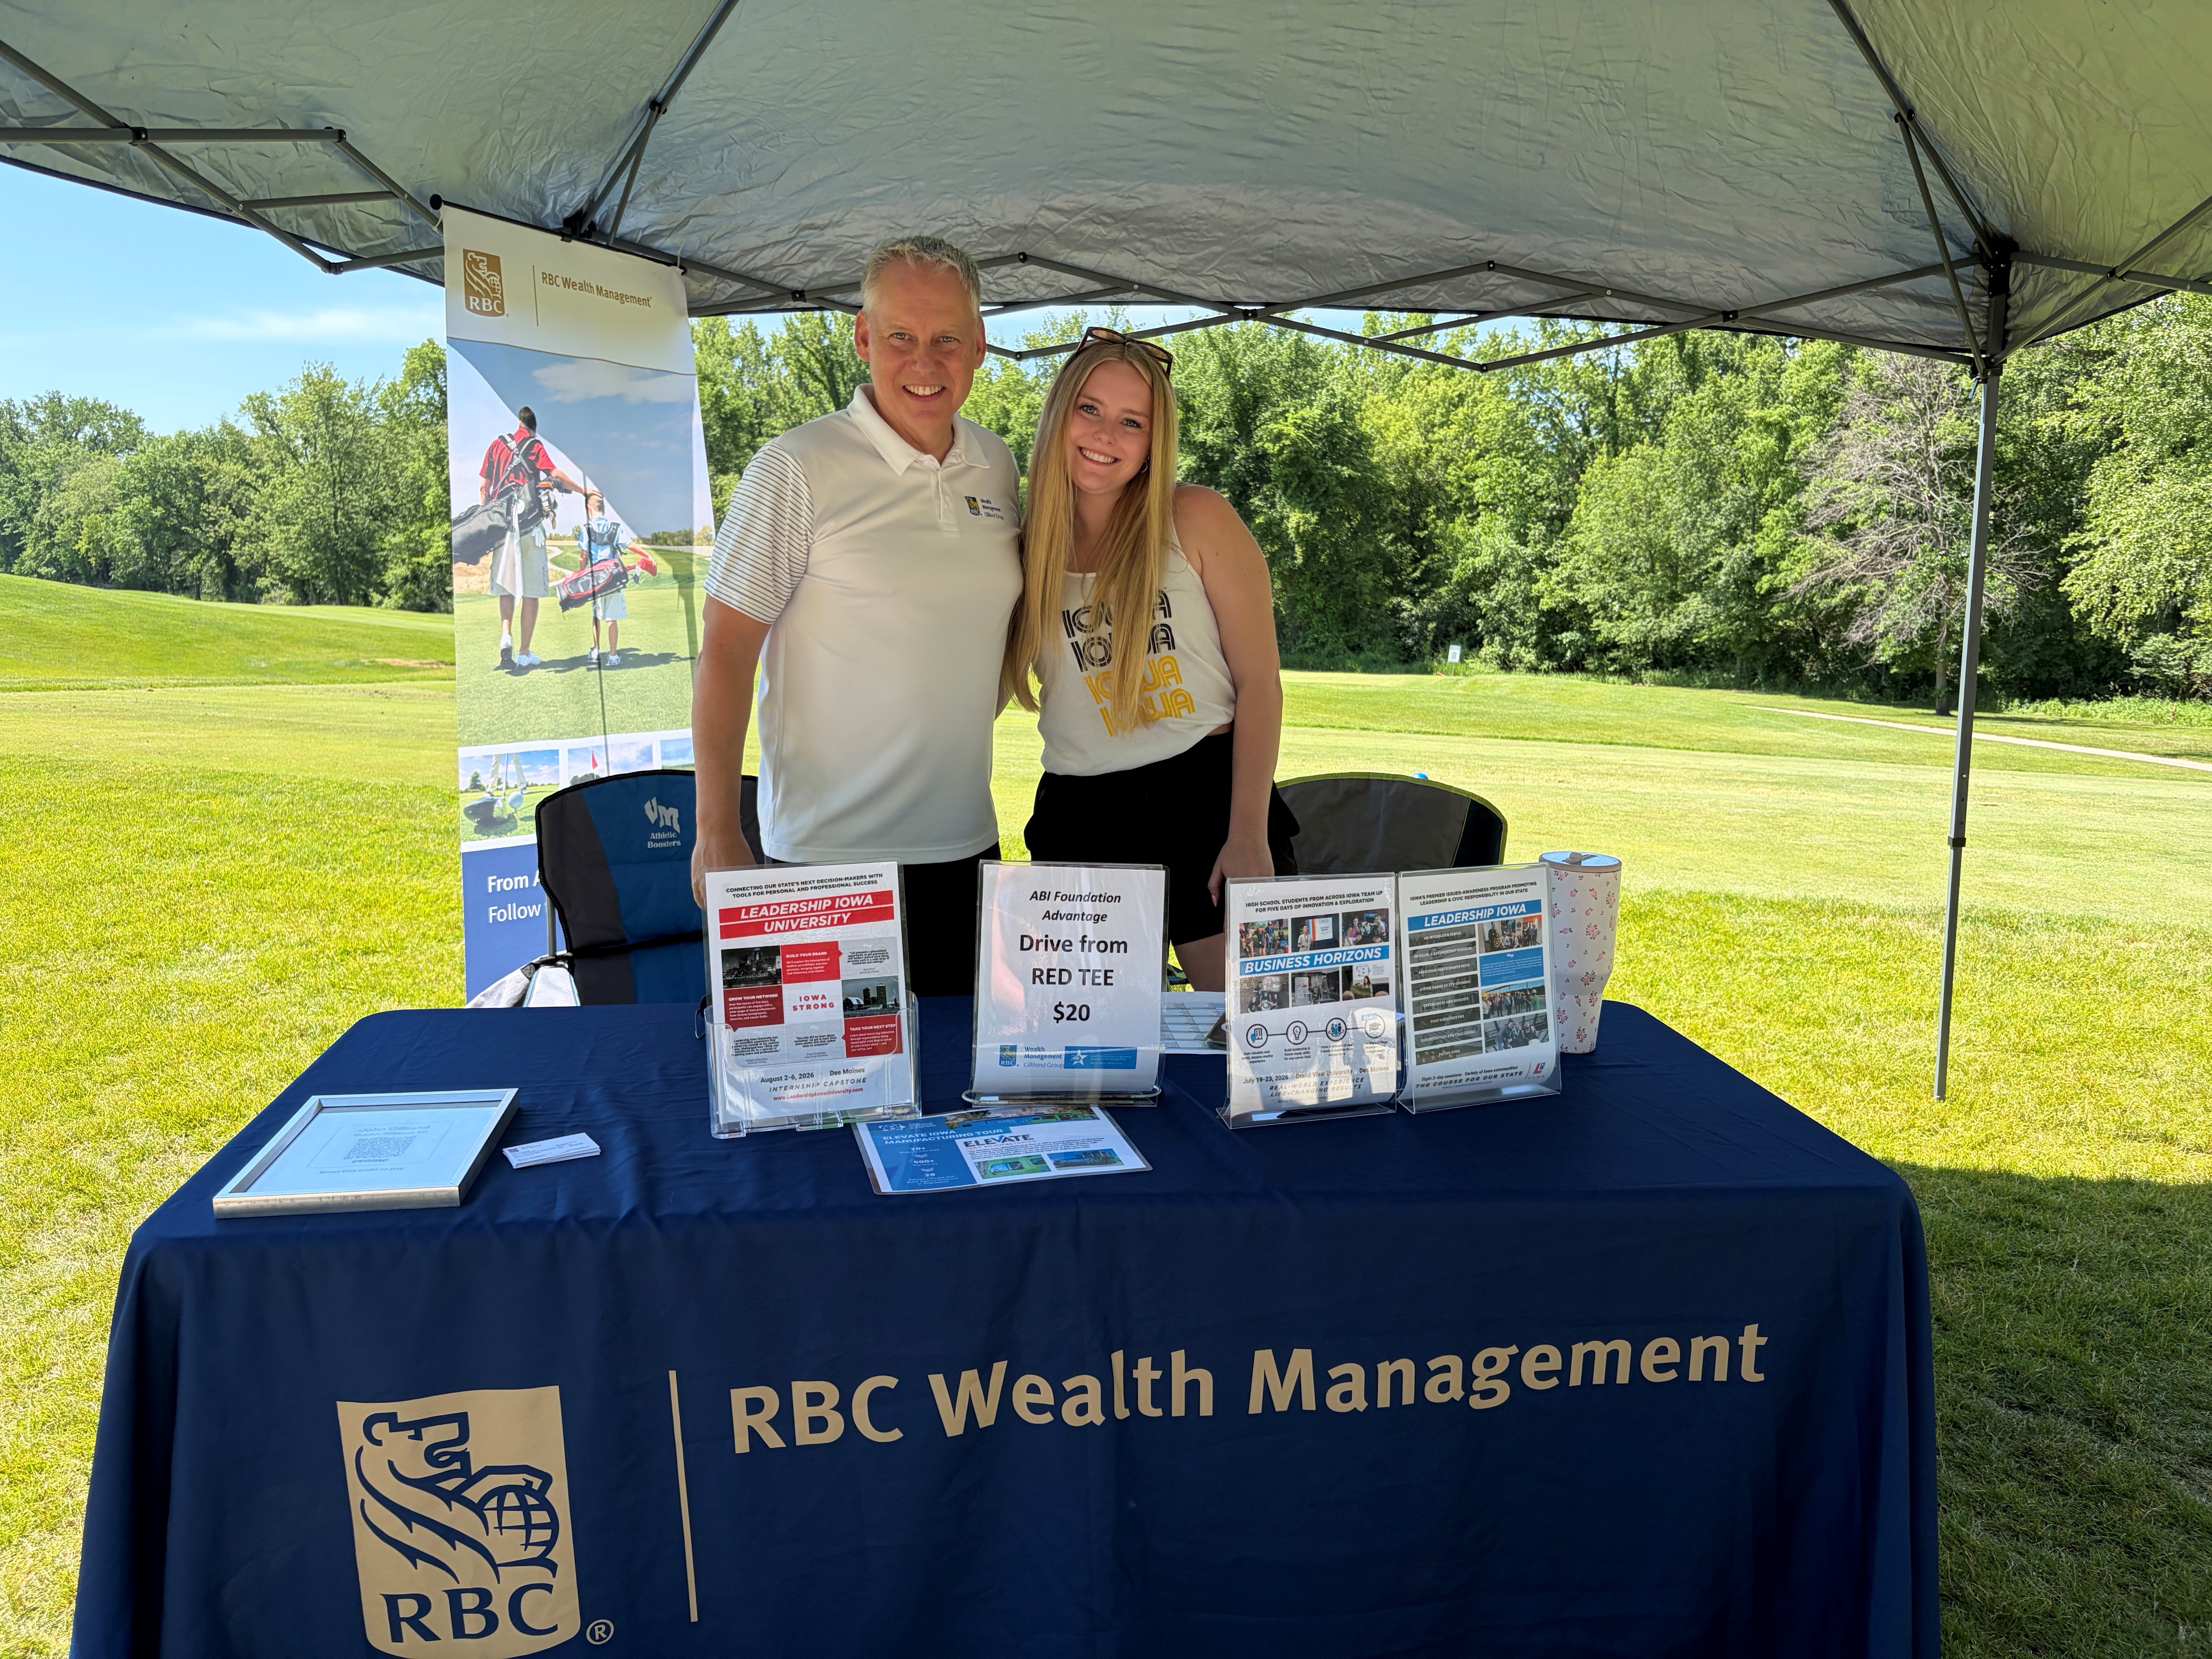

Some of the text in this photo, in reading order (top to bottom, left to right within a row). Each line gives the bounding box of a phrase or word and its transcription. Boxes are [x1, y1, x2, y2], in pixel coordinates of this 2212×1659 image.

[542, 271, 651, 307] RBC Wealth Management
[469, 296, 502, 313] RBC
[651, 831, 677, 840] Athletic
[488, 875, 529, 893] From
[817, 875, 867, 884] DECISION-MAKERS
[1029, 891, 1121, 903] ABI Foundation
[1446, 888, 1489, 896] ISSUES-AWARENESS
[489, 903, 541, 924] Follow
[740, 894, 873, 919] LEADERSHIP IOWA
[1424, 903, 1526, 927] LEADERSHIP IOWA
[764, 913, 852, 932] UNIVERSITY
[1042, 910, 1108, 924] Advantage
[1019, 934, 1128, 953] Drive from
[1245, 948, 1381, 974] BUSINESS HORIZONS
[1032, 968, 1114, 986] RED TEE
[793, 1002, 834, 1011] STRONG
[1053, 1001, 1090, 1024] $20
[769, 1078, 867, 1092] INTERNSHIP CAPSTONE
[1269, 1077, 1364, 1091] REAL-WORLD EXPERIENCE
[1271, 1087, 1328, 1097] LIFE-CHANGING
[885, 1132, 973, 1144] MANUFACTURING
[964, 1134, 1034, 1147] ELEVATE
[730, 1322, 1769, 1454] RBC Wealth Management
[380, 1582, 558, 1644] RBC
